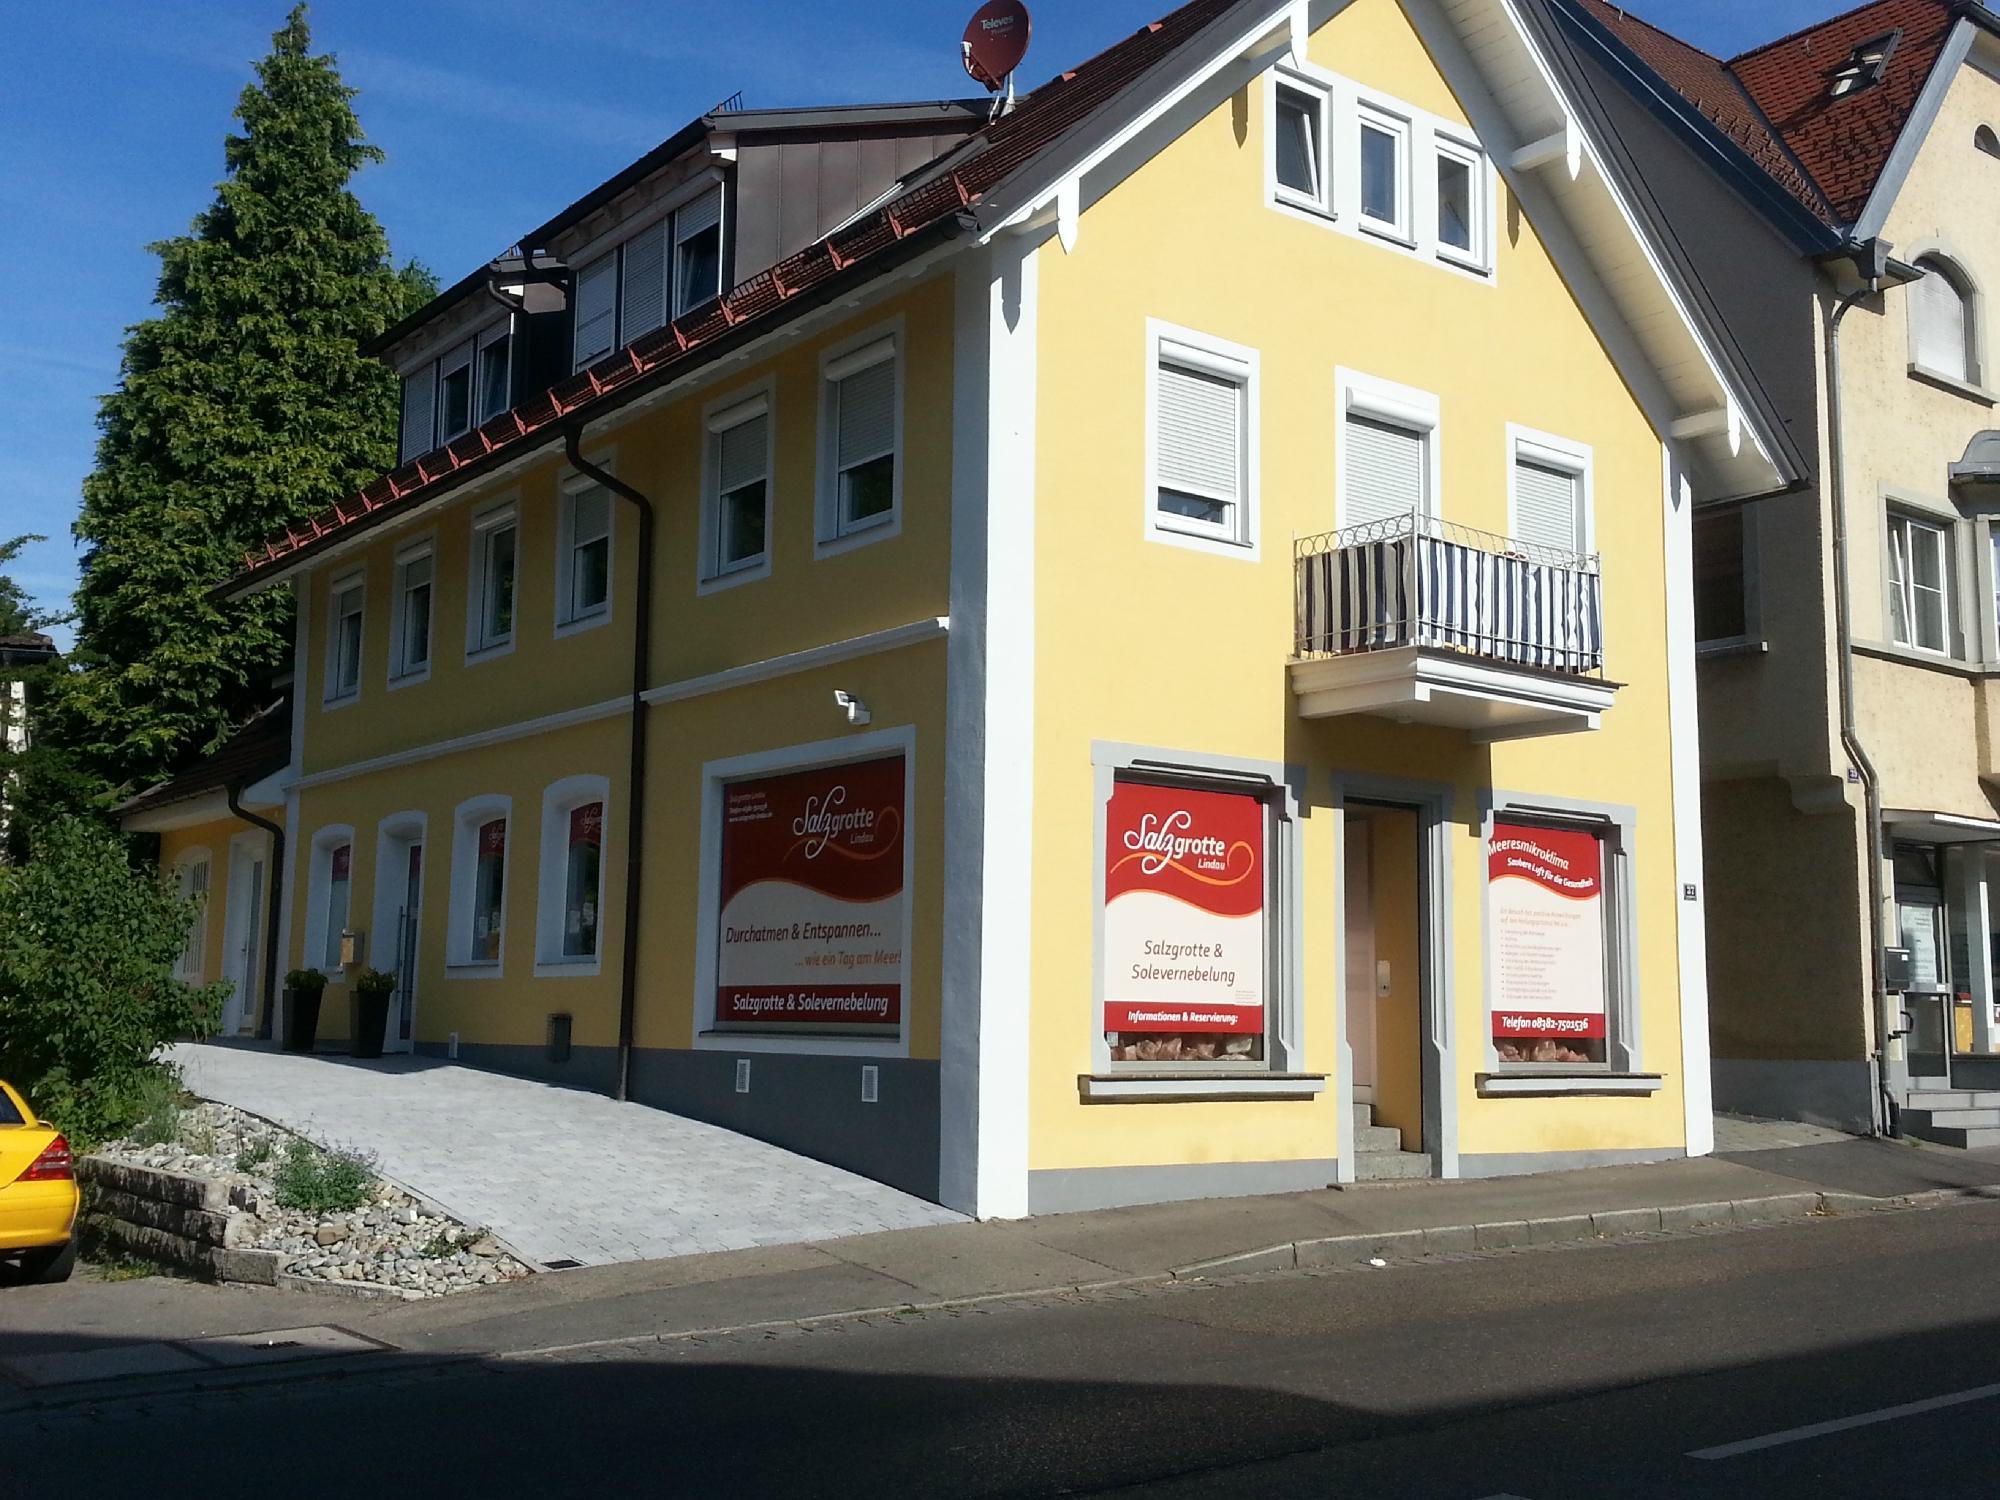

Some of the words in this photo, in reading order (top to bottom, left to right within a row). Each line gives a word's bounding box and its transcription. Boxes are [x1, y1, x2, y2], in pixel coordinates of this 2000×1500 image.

[980, 15, 1014, 30] Televes
[793, 785, 874, 859] Salzgrotte
[850, 832, 874, 844] Lindau
[1124, 810, 1225, 875] Salzgrotte
[1198, 858, 1226, 870] Lindau
[1488, 839, 1569, 870] Meeresmikroklima
[1507, 857, 1531, 871] Saubere
[1532, 864, 1545, 877] Luft
[1543, 870, 1553, 880] für
[1554, 874, 1562, 885] die
[726, 924, 788, 943] Durchatmen
[792, 923, 800, 939] &
[803, 922, 881, 944] Entspannen...
[822, 950, 836, 965] ein
[838, 950, 854, 969] Tag
[857, 953, 872, 964] am
[1144, 939, 1210, 960] Salzgrotte
[1214, 943, 1223, 958] &
[1131, 963, 1235, 987] Solevernebelung
[733, 993, 784, 1015] Salzgrotte
[787, 993, 795, 1010] &
[798, 992, 889, 1017] Solevernebelung
[1128, 1010, 1180, 1023] Informationen
[1182, 1011, 1188, 1021] &
[1189, 1011, 1238, 1025] Reservierung:
[1502, 1015, 1530, 1031] Telefon
[1532, 1016, 1588, 1031] 08382-7501536
